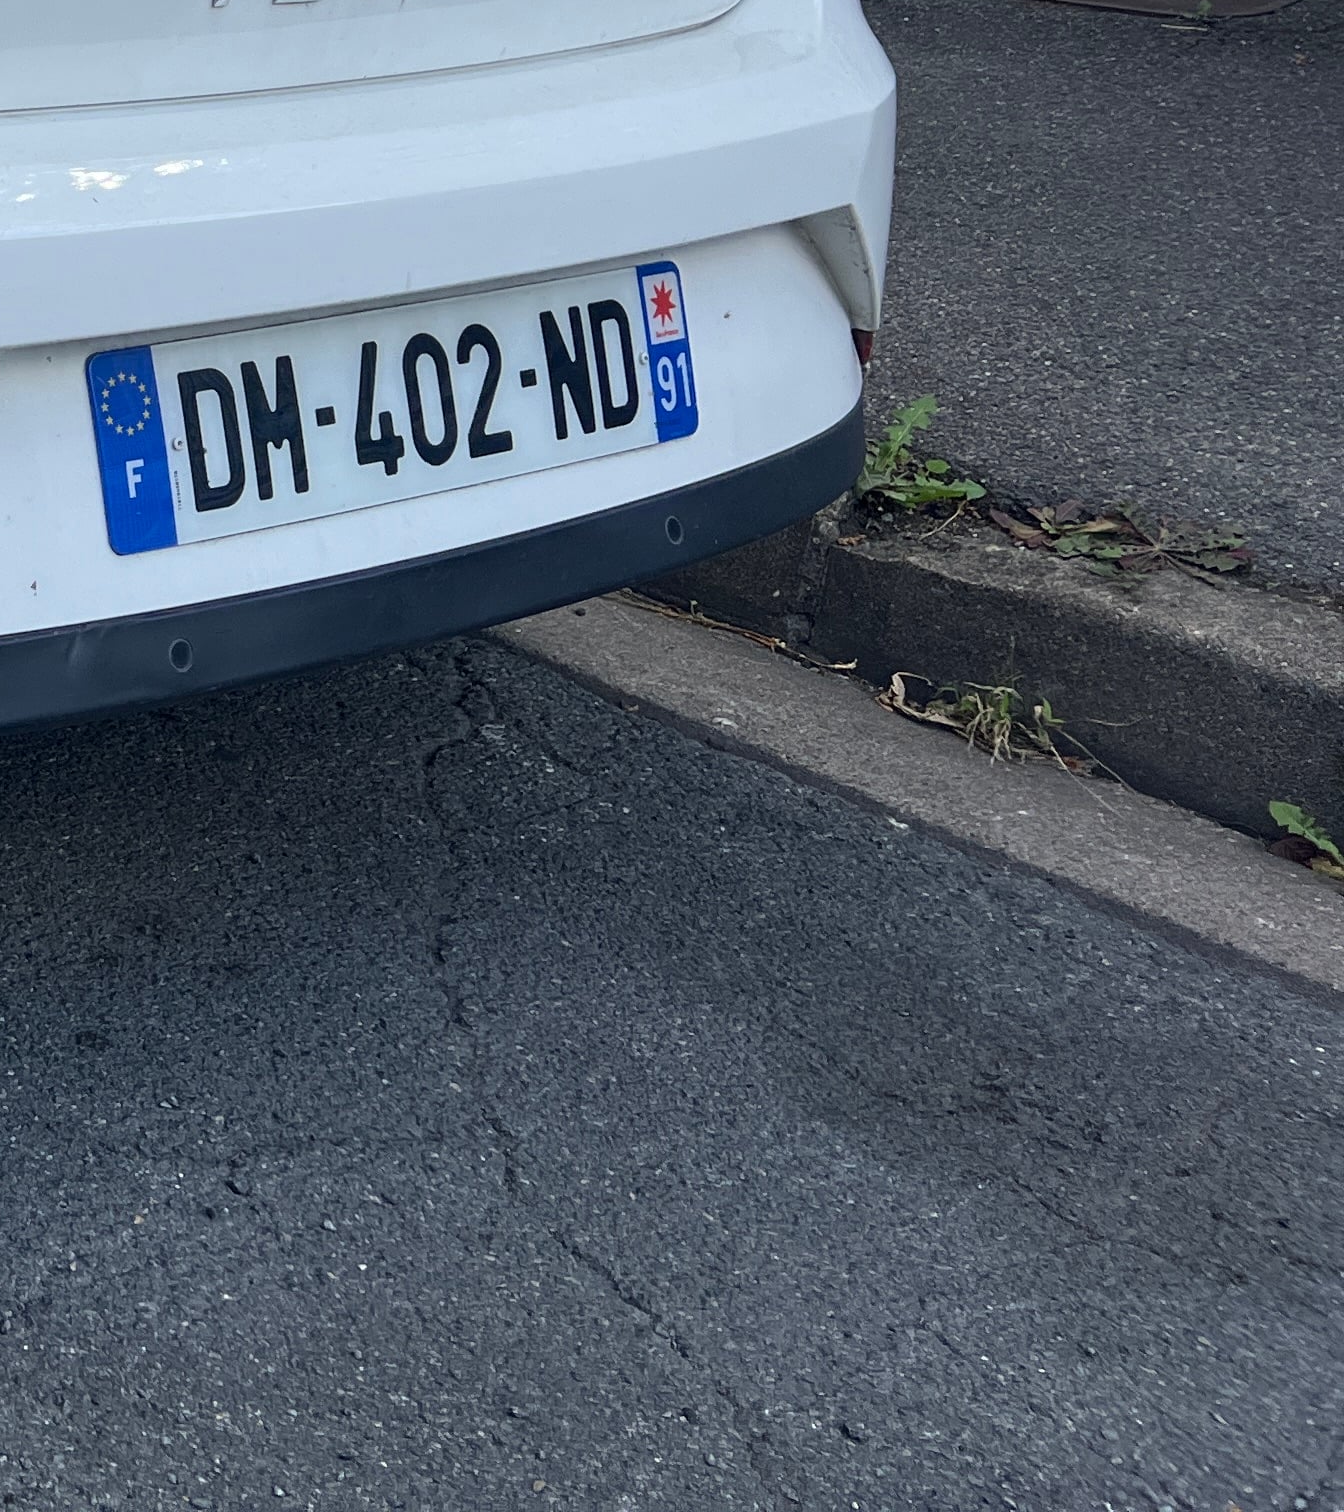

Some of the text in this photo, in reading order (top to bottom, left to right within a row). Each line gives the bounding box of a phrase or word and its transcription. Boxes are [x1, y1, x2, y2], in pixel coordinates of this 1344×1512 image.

[177, 298, 640, 512] DM-402-ND
[657, 351, 692, 412] 91
[125, 458, 145, 499] F
